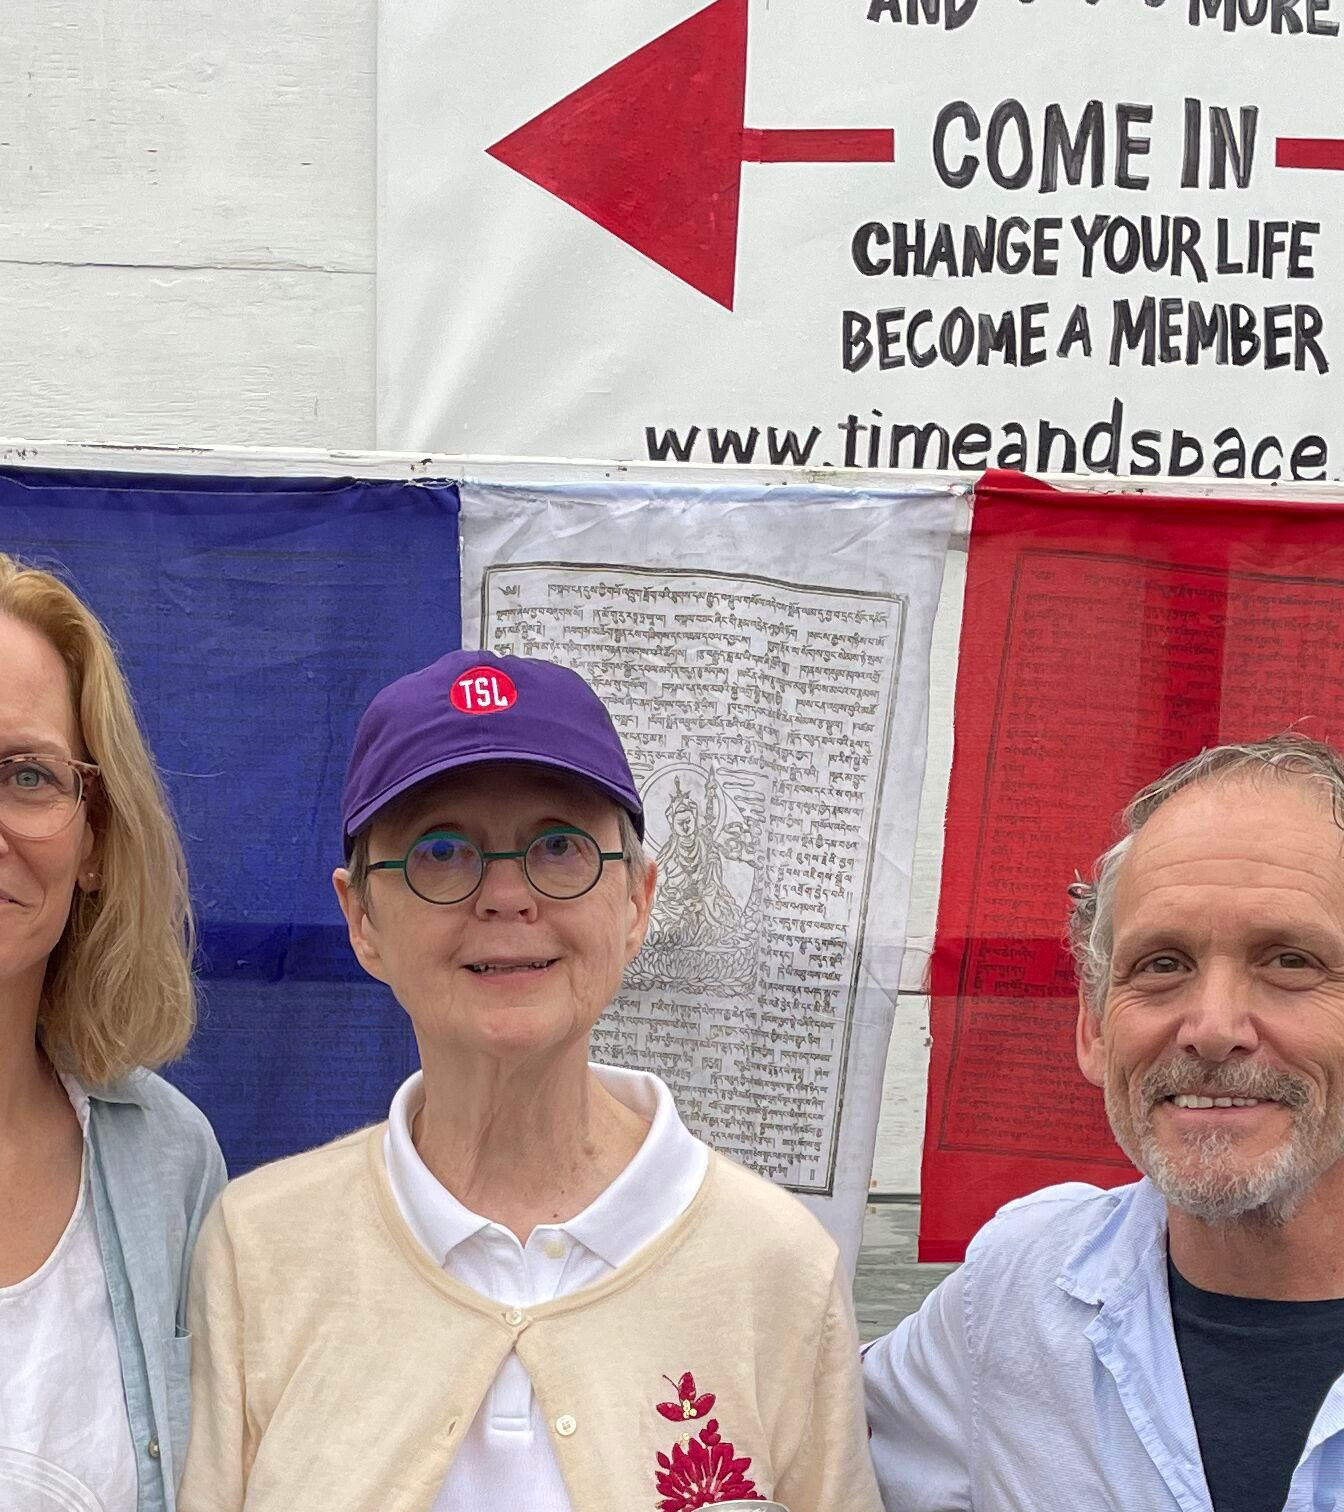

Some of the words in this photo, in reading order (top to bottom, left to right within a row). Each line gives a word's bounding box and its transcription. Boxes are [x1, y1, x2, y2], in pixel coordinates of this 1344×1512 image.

[932, 98, 1154, 194] COME
[1180, 97, 1260, 191] IN
[851, 215, 1064, 279] CHANGE
[1070, 214, 1208, 283] YOUR
[1217, 217, 1321, 280] LIFE
[842, 306, 1050, 373] BECOME
[1056, 304, 1092, 358] A
[1109, 295, 1329, 375] MEMBER
[459, 676, 508, 708] TSL
